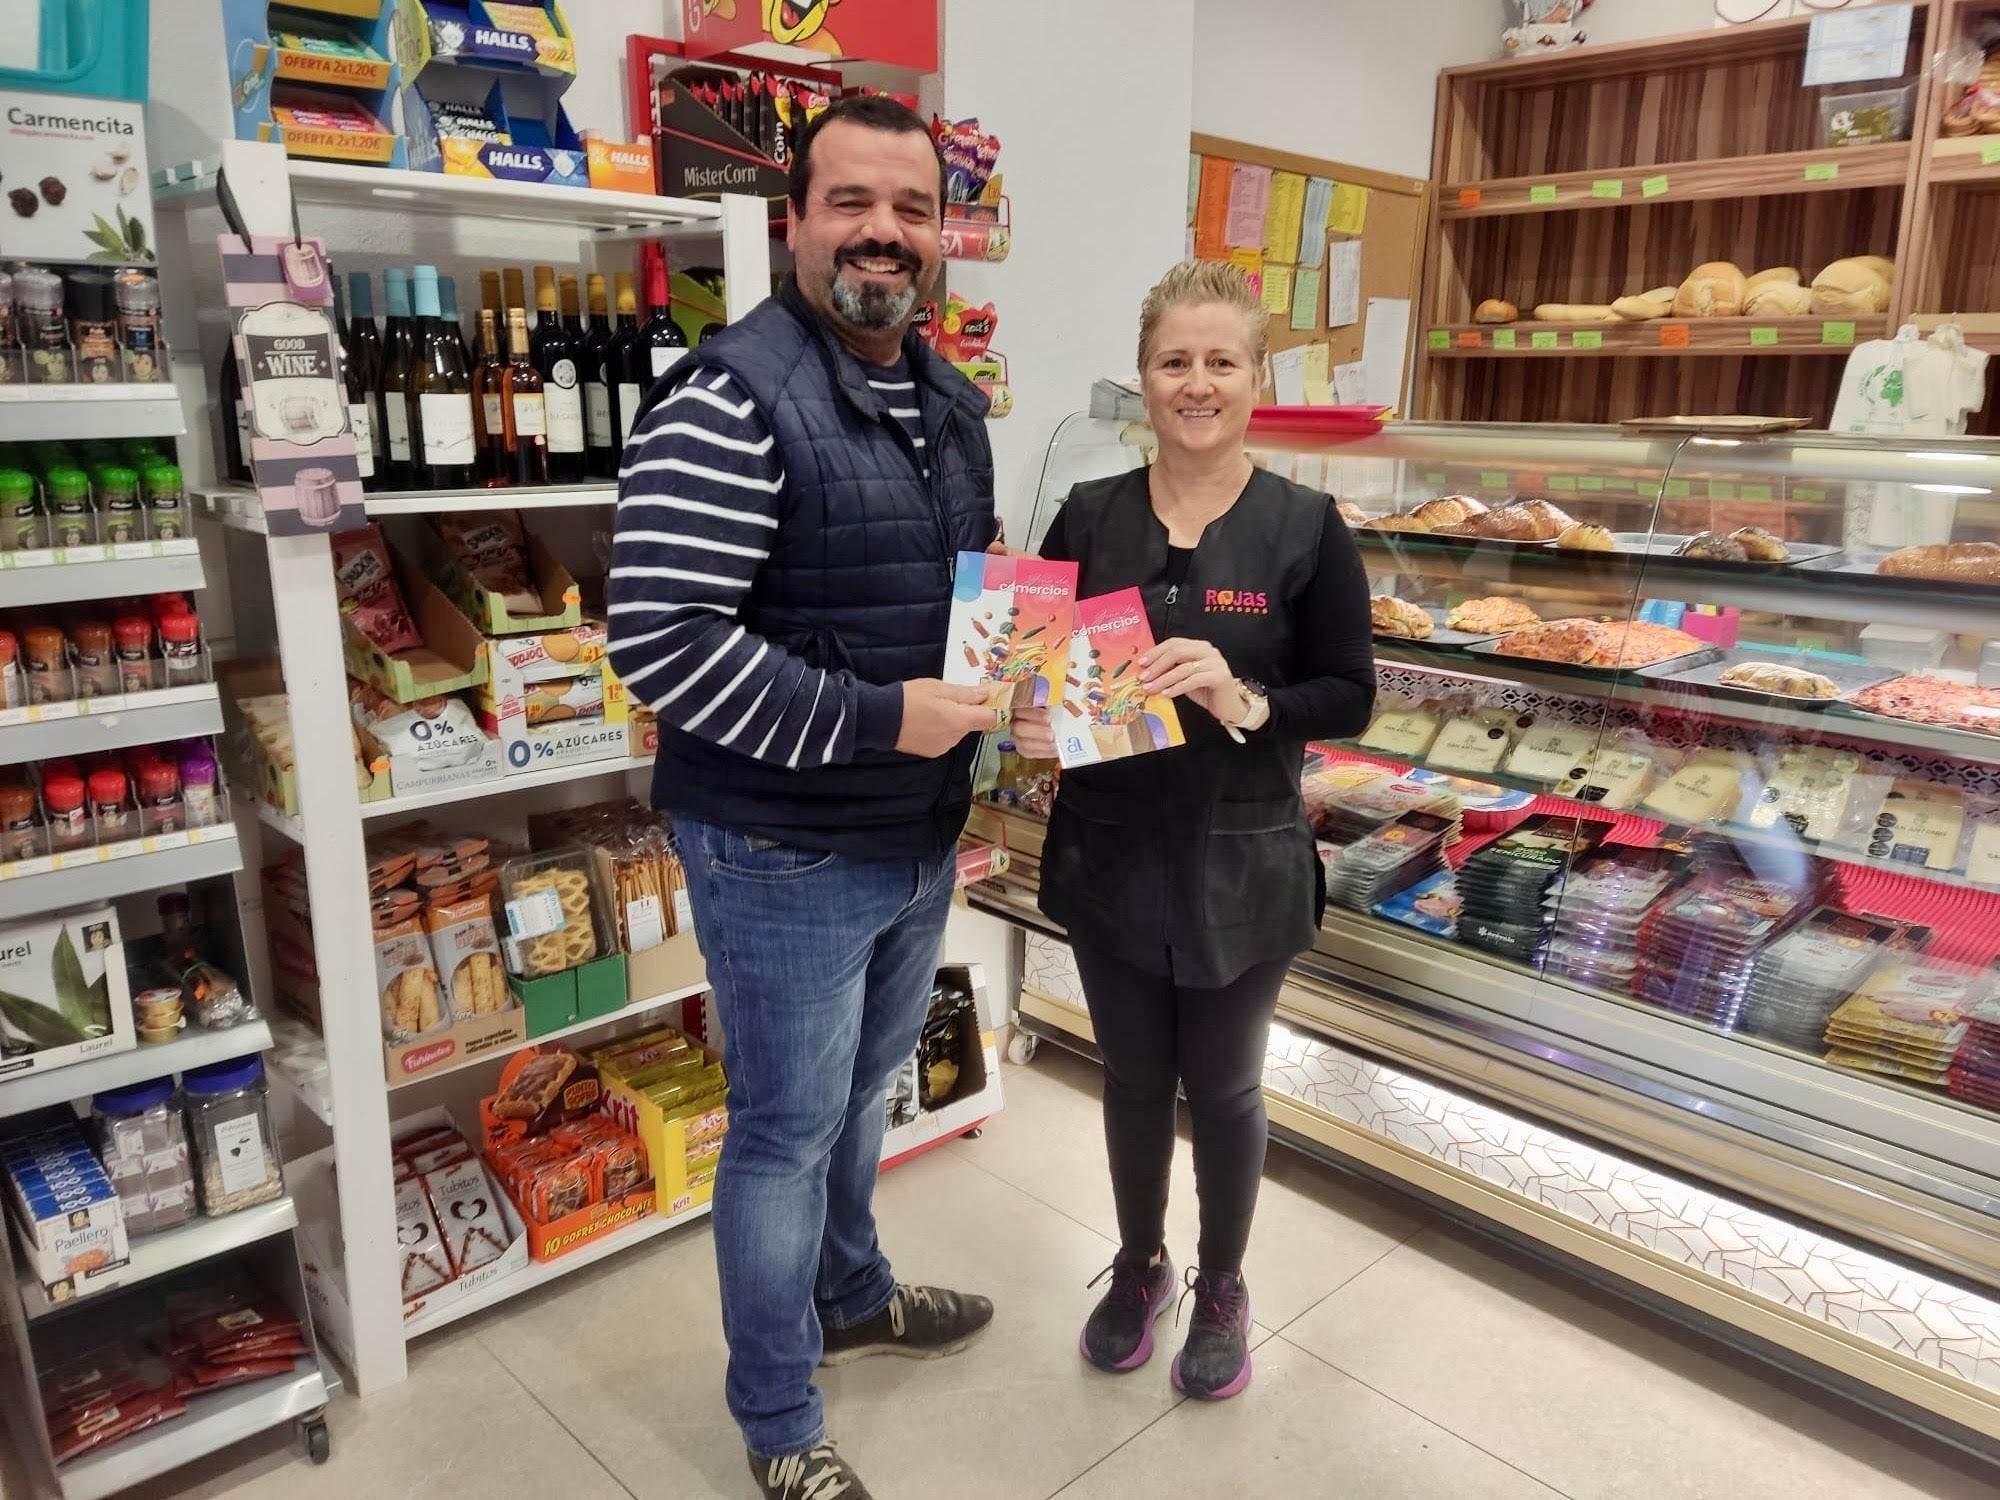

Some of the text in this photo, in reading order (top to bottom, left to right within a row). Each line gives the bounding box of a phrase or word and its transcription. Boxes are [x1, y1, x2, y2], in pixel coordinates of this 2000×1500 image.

[475, 30, 533, 51] HALLS
[284, 55, 330, 72] OFERTA
[8, 107, 134, 135] Carmencita
[287, 131, 334, 147] OFERTA
[773, 121, 786, 164] Corn
[488, 151, 545, 171] HALLS
[611, 152, 649, 165] HALLS
[684, 163, 756, 187] MisterCorn
[273, 338, 306, 350] GOOD
[265, 353, 319, 376] WINE
[999, 580, 1069, 597] comercios
[1071, 614, 1140, 638] comercios
[556, 731, 623, 750] AZÚCARES
[80, 1039, 113, 1054] Laurel
[50, 1176, 81, 1191] 100
[55, 1185, 87, 1201] 100
[439, 1175, 480, 1196] Tubitos
[59, 1195, 92, 1212] 100
[672, 1195, 690, 1212] Krit
[544, 1236, 561, 1257] 10
[600, 1197, 653, 1232] CHOCOLATE
[55, 1227, 109, 1251] Paellero
[457, 1267, 498, 1292] Tubitos
